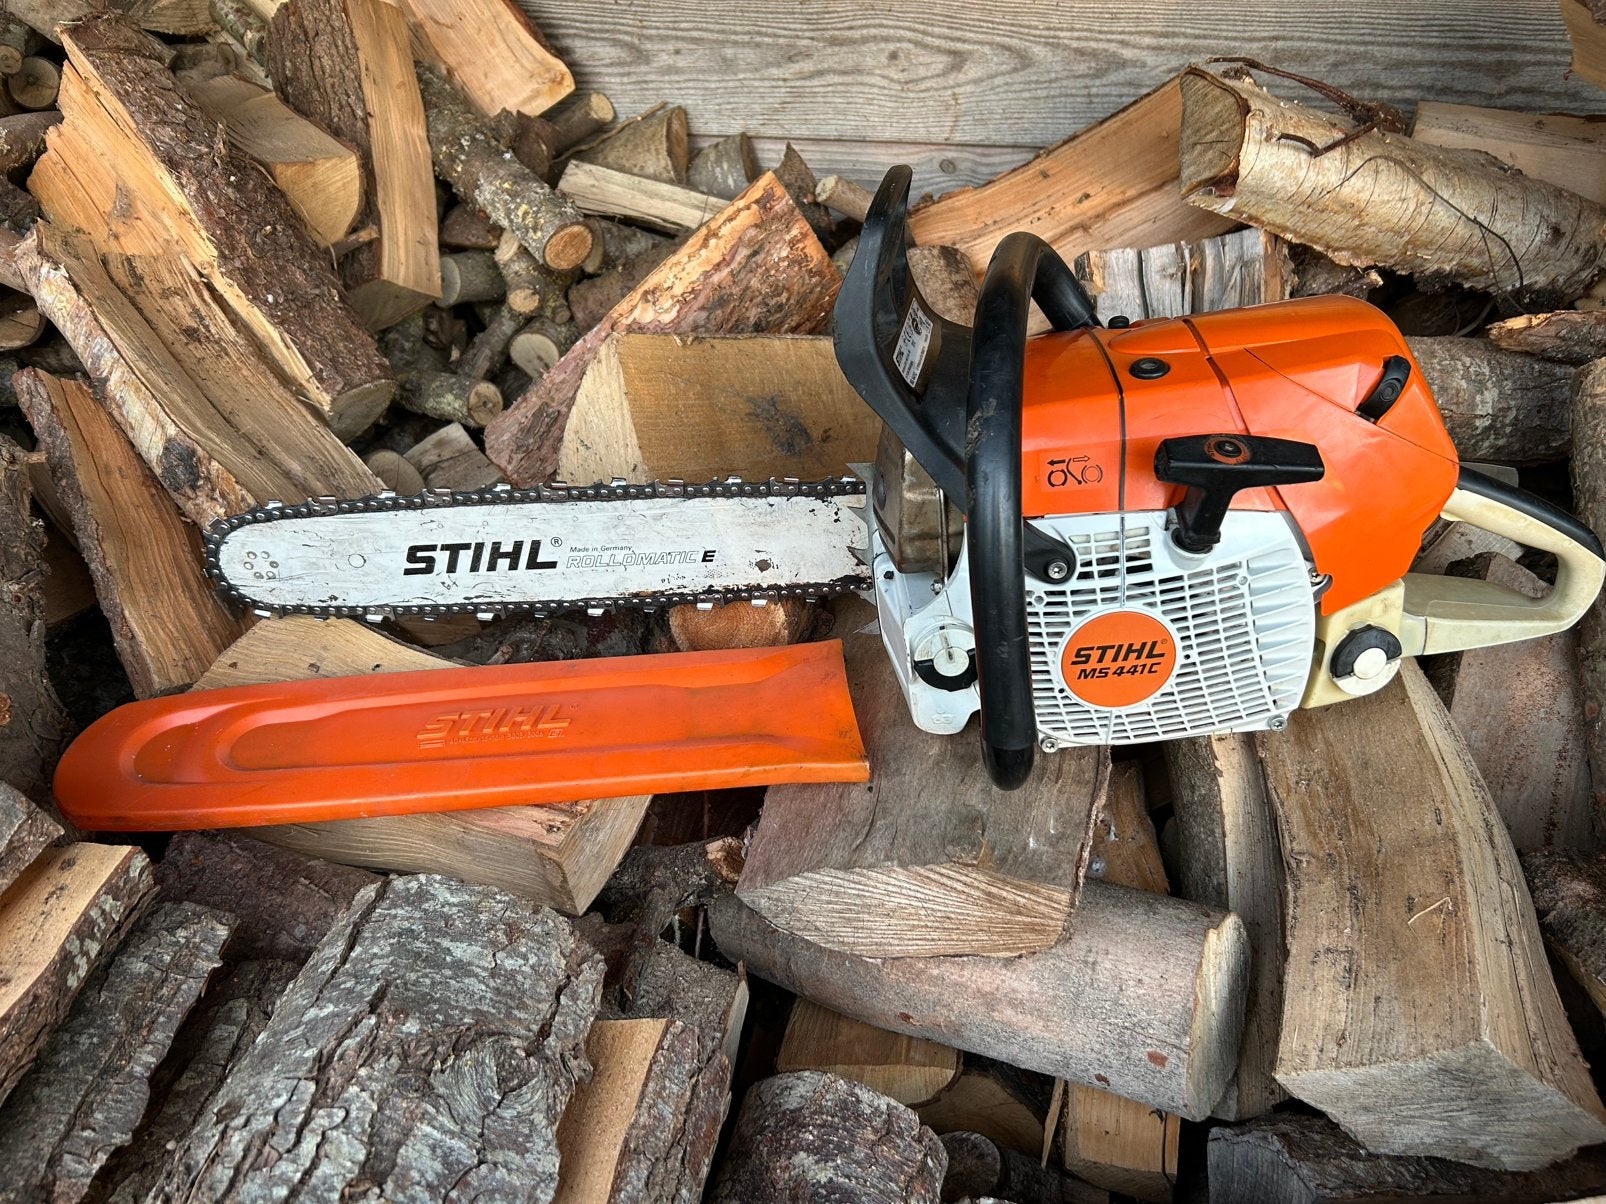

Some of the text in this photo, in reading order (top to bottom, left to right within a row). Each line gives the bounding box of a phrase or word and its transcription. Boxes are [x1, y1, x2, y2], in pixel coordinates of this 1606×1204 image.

[403, 540, 558, 575] STIHL
[566, 550, 716, 568] ROLLOMATIC E
[1070, 641, 1166, 665] STIHL
[1077, 667, 1110, 680] MS
[417, 703, 571, 740] STIHL
